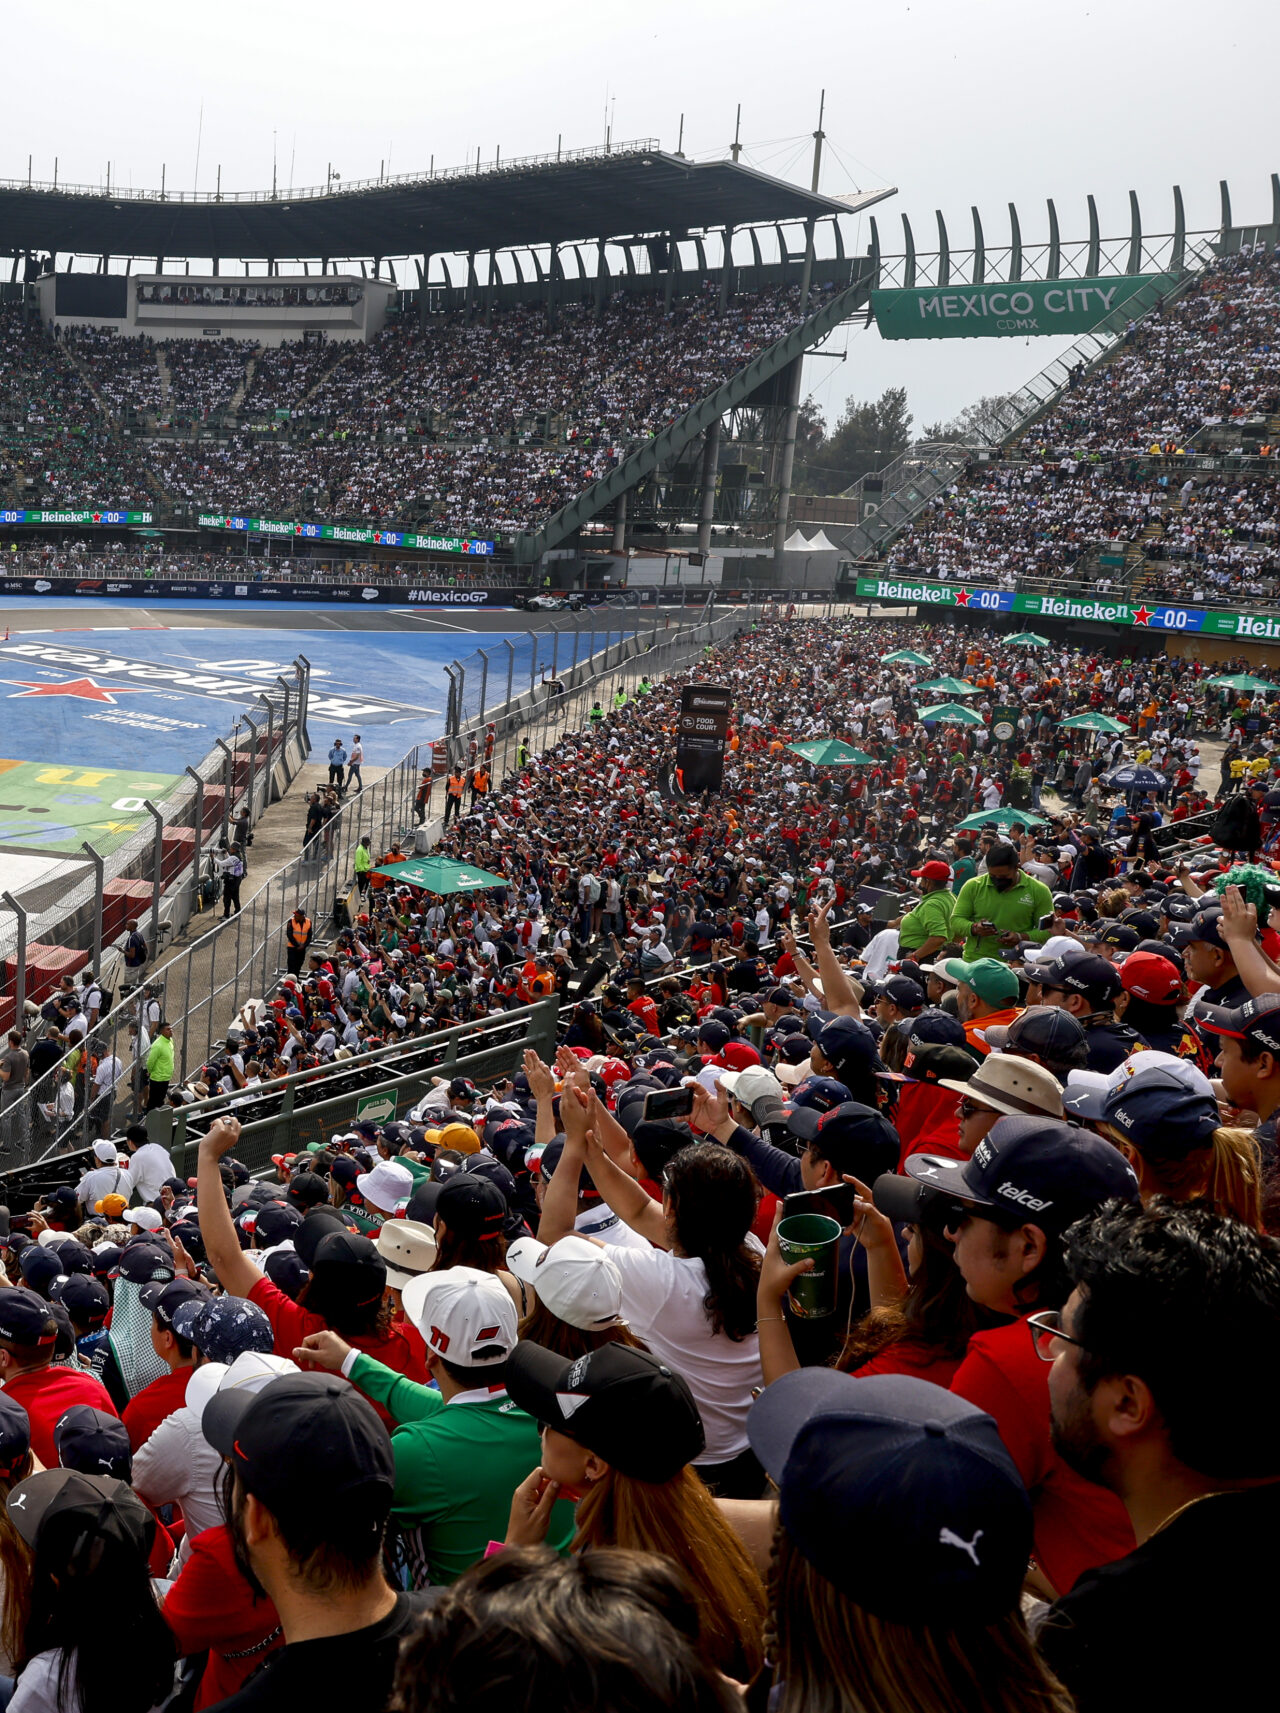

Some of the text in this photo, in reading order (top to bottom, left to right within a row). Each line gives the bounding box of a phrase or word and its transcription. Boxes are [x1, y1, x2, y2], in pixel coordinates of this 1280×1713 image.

[918, 286, 1118, 319] MEXICO CITY
[996, 318, 1040, 331] CDMX
[41, 510, 89, 523] Heineken
[259, 521, 294, 534] Heineken
[333, 527, 372, 541] Heineken
[416, 536, 459, 550] Heineken
[408, 590, 489, 603] #MexicoGP
[877, 581, 1000, 609] Heineken 0.0
[1040, 597, 1128, 620] Heineken
[1164, 610, 1187, 629] 0.0
[696, 716, 715, 725] FOOD
[695, 724, 718, 732] COURT
[1064, 975, 1090, 990] telcel
[1114, 1107, 1134, 1129] telcel
[997, 1180, 1054, 1212] telcel
[157, 1304, 172, 1324] telcel
[430, 1324, 451, 1355] 11
